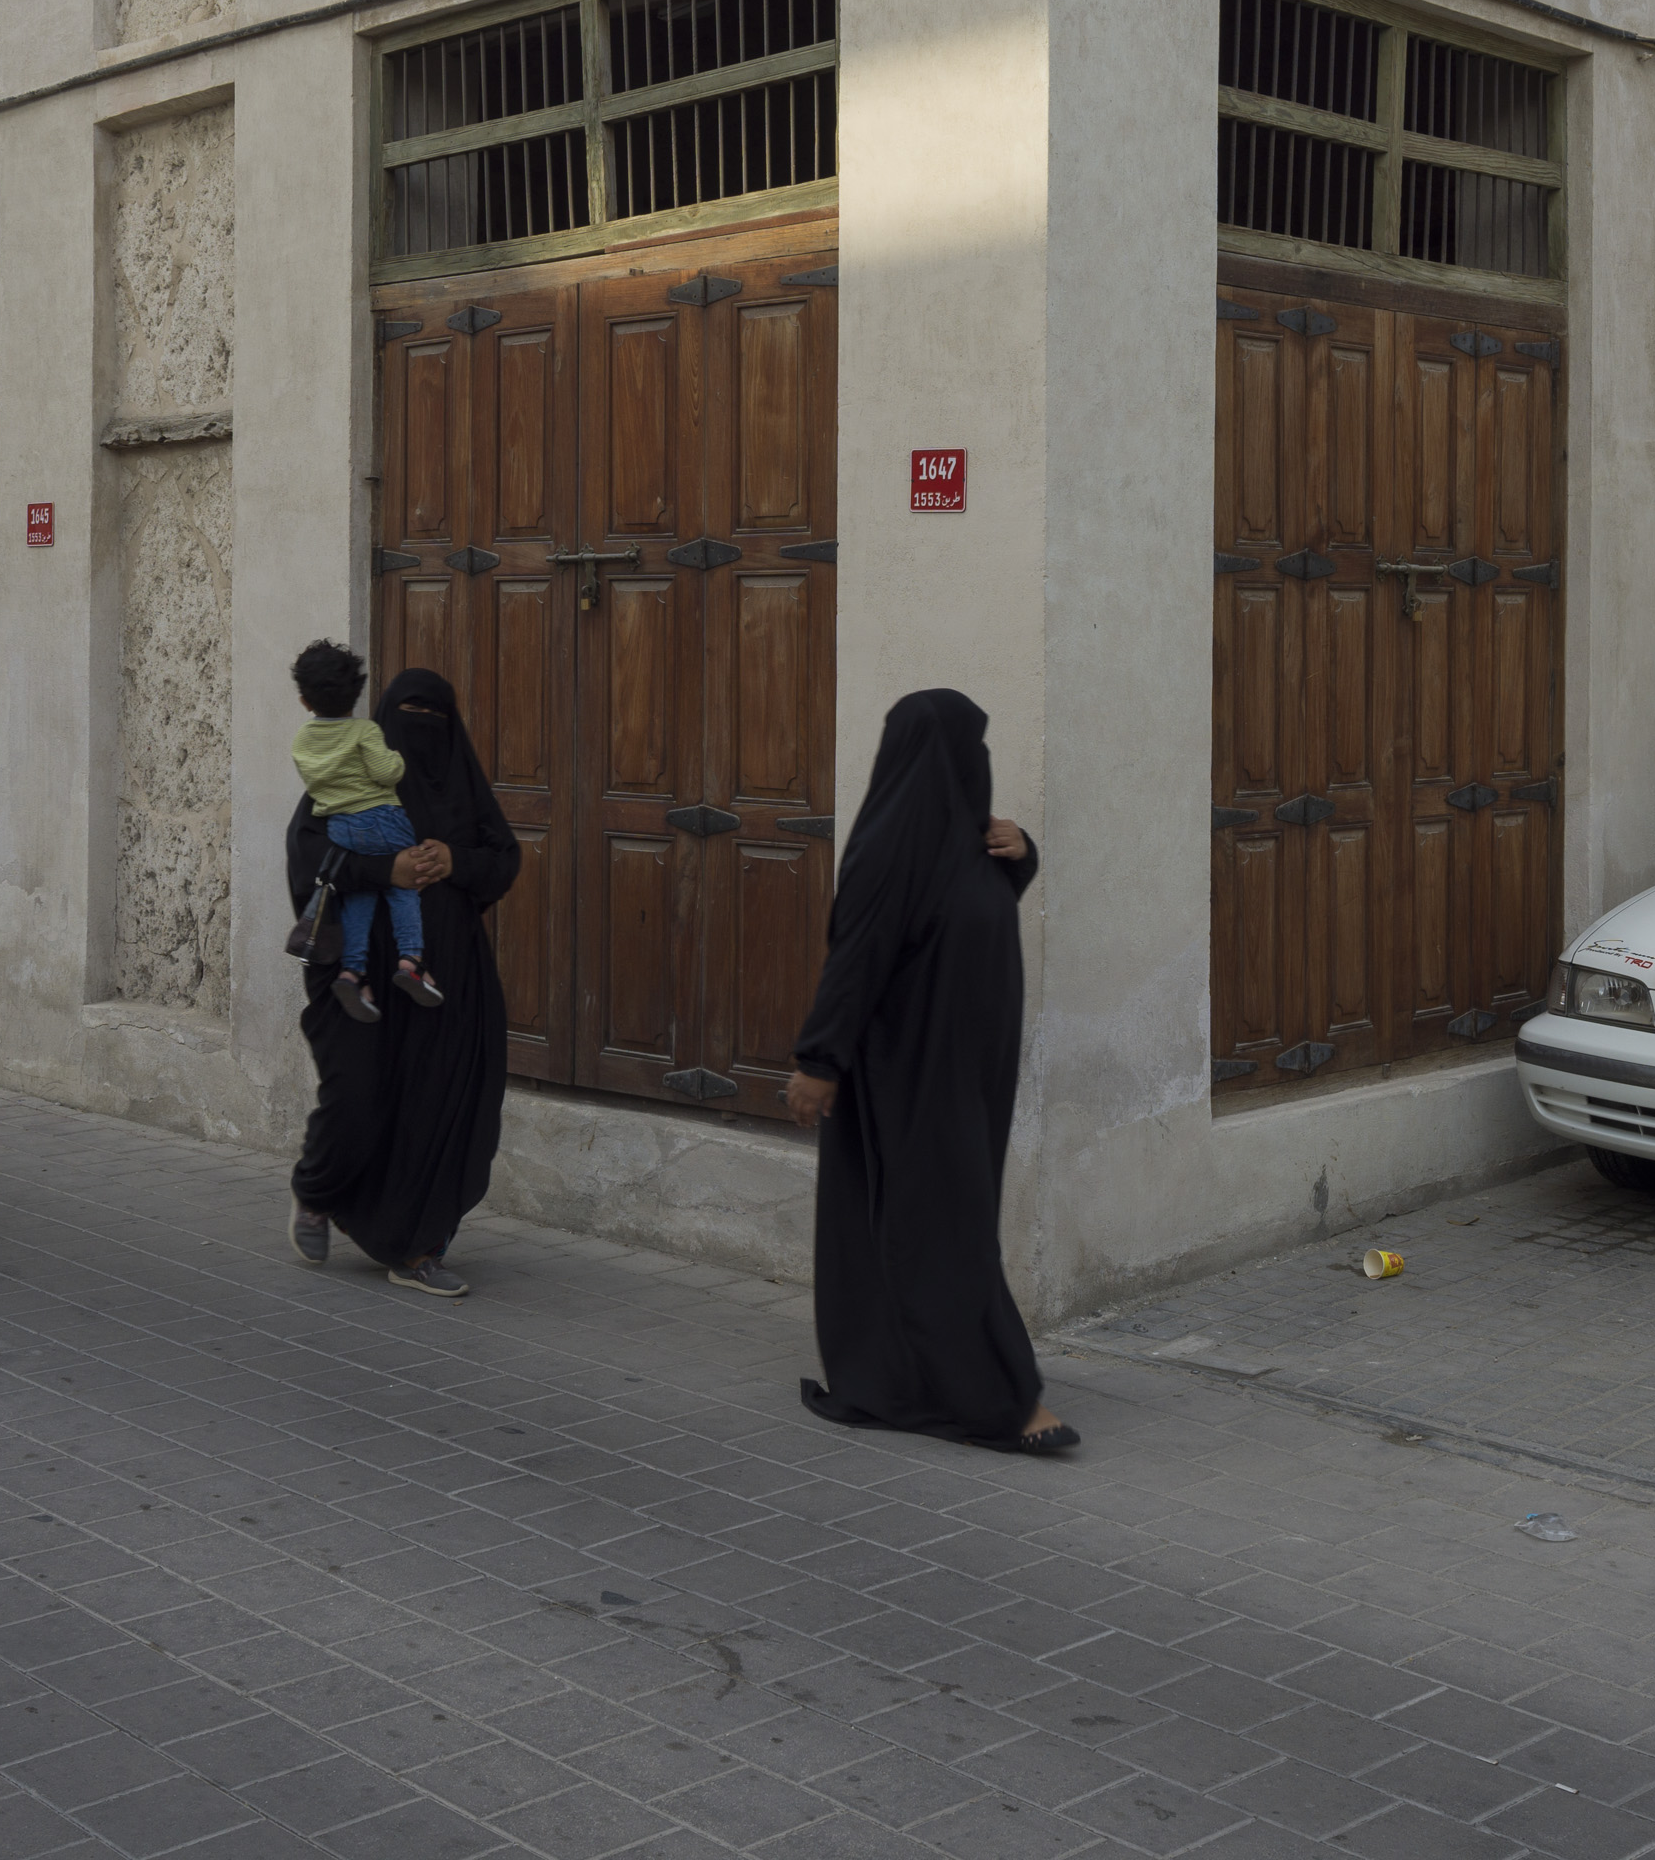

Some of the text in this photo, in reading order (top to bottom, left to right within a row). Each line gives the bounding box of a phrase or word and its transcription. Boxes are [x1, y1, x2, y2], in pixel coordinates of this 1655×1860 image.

[919, 456, 957, 481] 1647
[914, 491, 961, 508] طريق 1553
[30, 508, 50, 525] 1645
[1624, 955, 1654, 969] TRD
